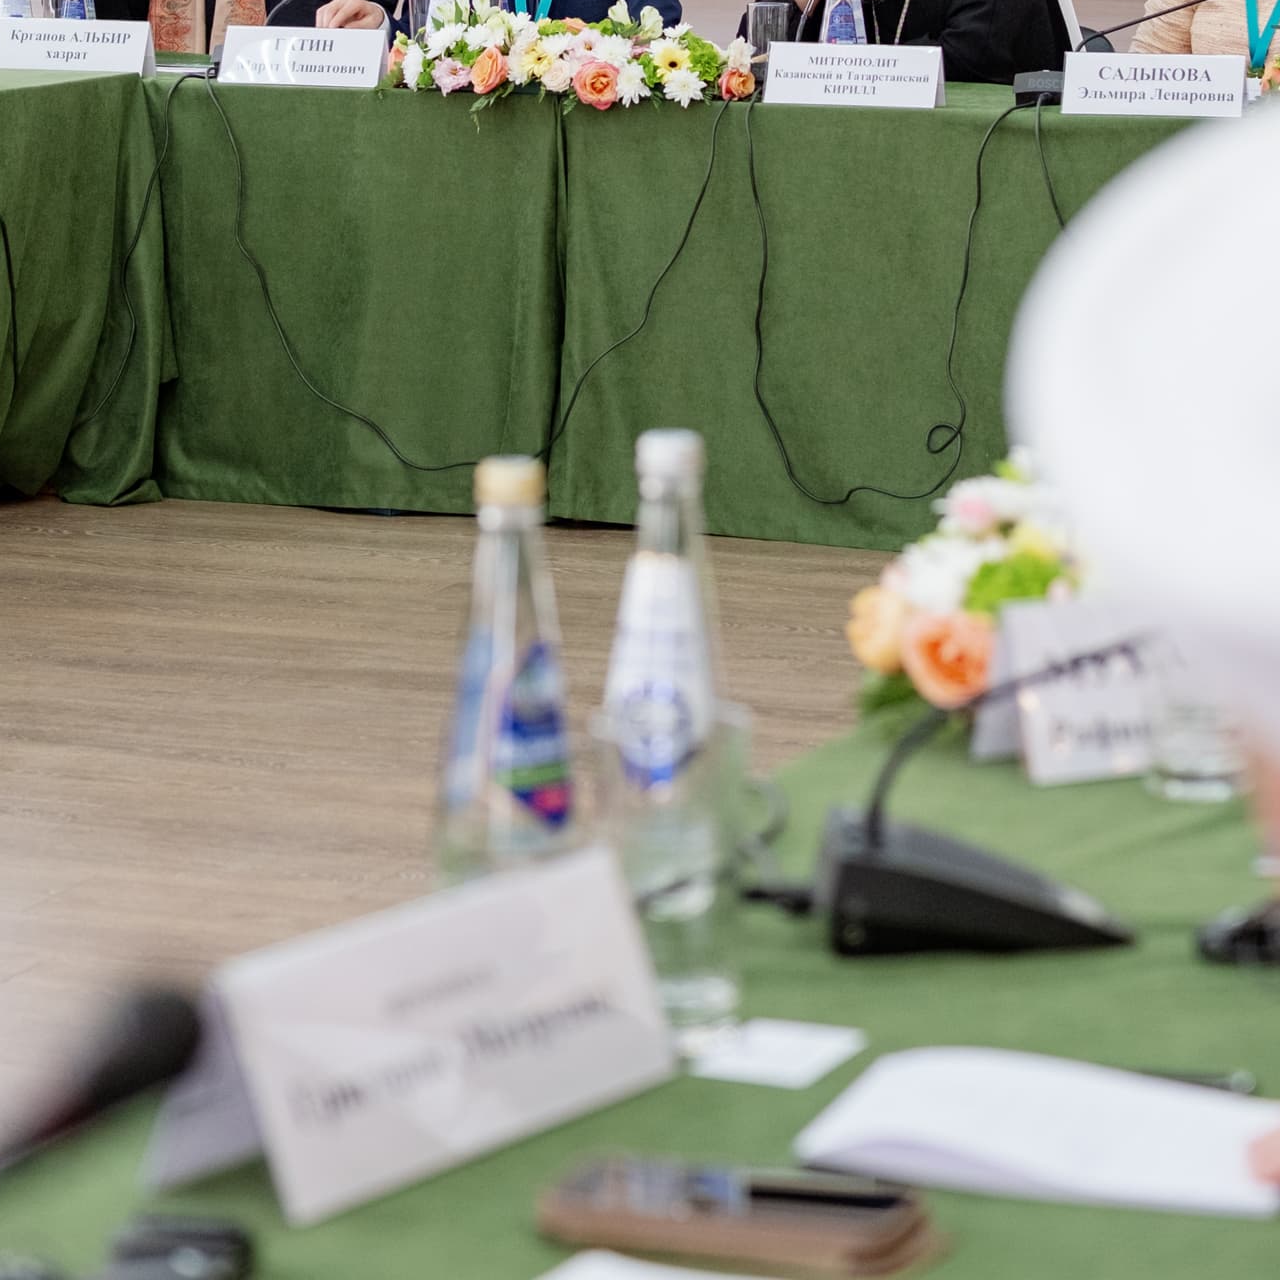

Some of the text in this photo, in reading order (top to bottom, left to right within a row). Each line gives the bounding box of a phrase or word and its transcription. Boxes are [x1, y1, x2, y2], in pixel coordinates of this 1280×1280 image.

[10, 29, 131, 44] Крганов АЛЬБИР
[274, 37, 335, 52] ГТИН
[46, 50, 88, 62] хазрат
[808, 56, 899, 68] МИТРОПОЛИТ
[775, 69, 833, 80] Казанский
[1098, 66, 1212, 82] САДЫКОВА
[824, 84, 877, 95] КИРИЛЛ
[1027, 78, 1064, 89] BOSC
[1078, 86, 1234, 104] Эльмира Ленаровна
